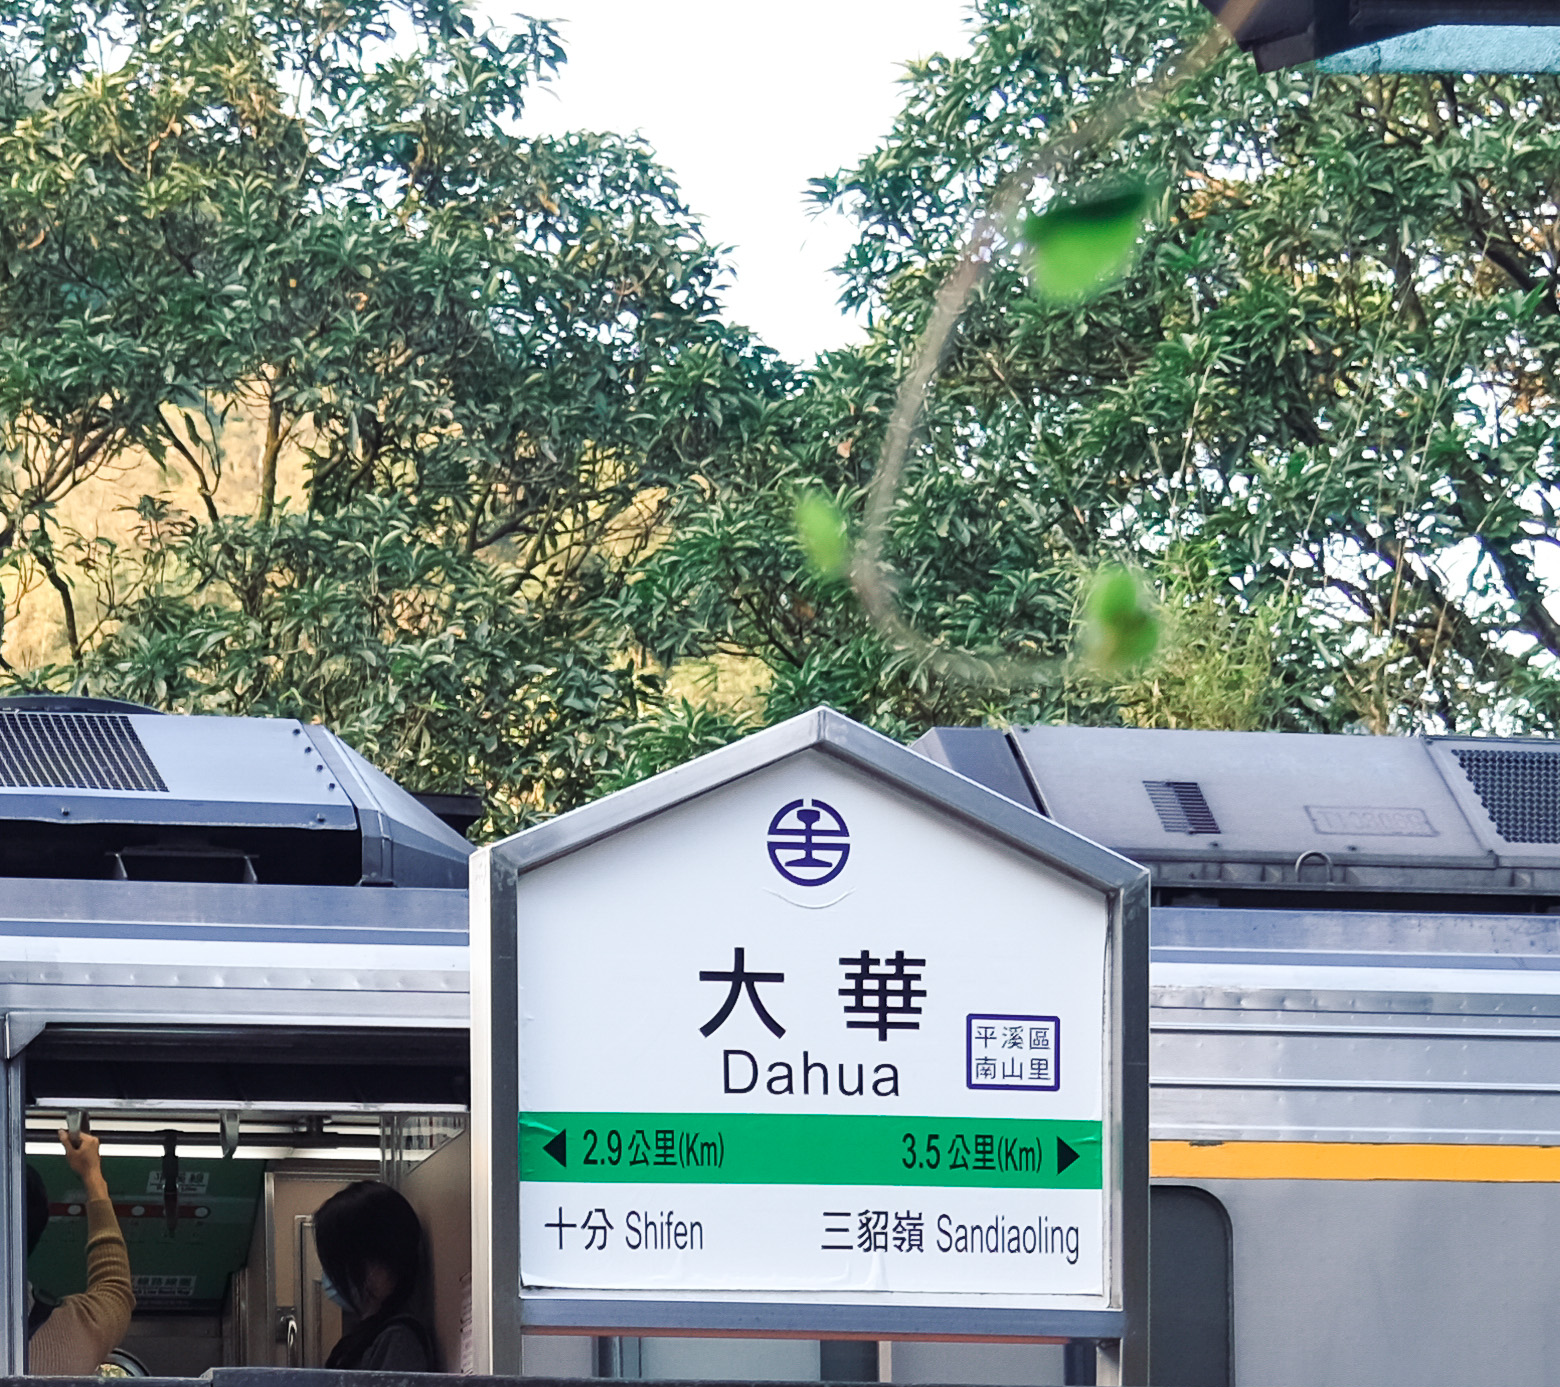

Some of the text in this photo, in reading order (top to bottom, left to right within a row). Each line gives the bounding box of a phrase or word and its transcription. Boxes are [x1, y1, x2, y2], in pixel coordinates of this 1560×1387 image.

[698, 946, 928, 1042] 大華
[974, 1025, 1051, 1050] 平溪區
[723, 1049, 900, 1097] Dahua
[974, 1055, 1051, 1081] 南山里
[544, 1206, 704, 1251] 十分 Shifen
[820, 1209, 1080, 1265] 三貂嶺 Sandiaoling
